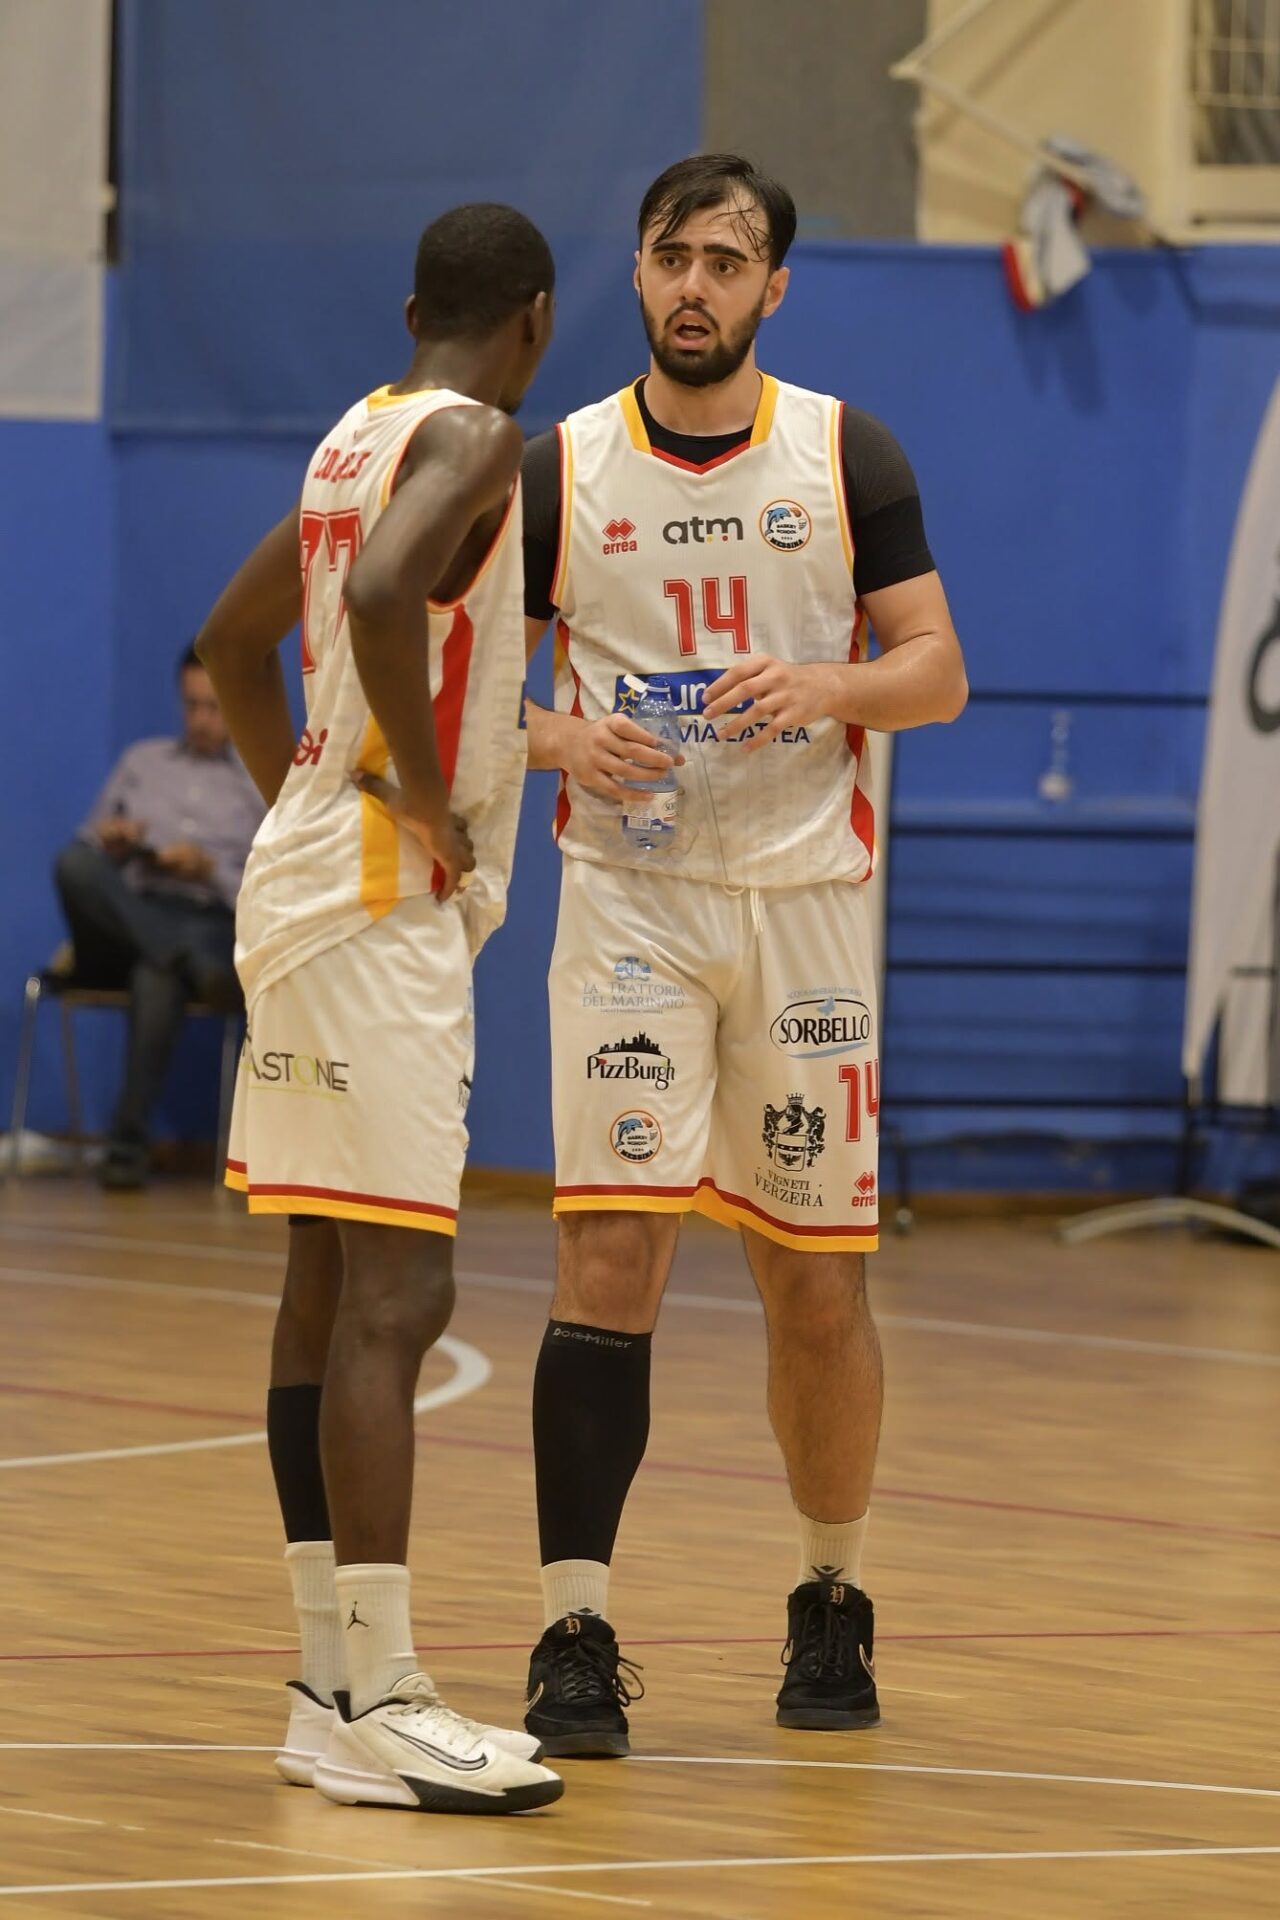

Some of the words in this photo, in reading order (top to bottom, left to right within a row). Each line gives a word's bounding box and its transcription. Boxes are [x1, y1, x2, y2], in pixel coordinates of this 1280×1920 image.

[662, 516, 744, 545] atm
[663, 576, 751, 656] 14
[608, 981, 685, 998] TRATTORIA
[779, 1014, 870, 1046] SORBELLO
[587, 1055, 676, 1091] PizzBurgh
[753, 1172, 824, 1207] VERZERA
[768, 1169, 810, 1190] VIGNETI
